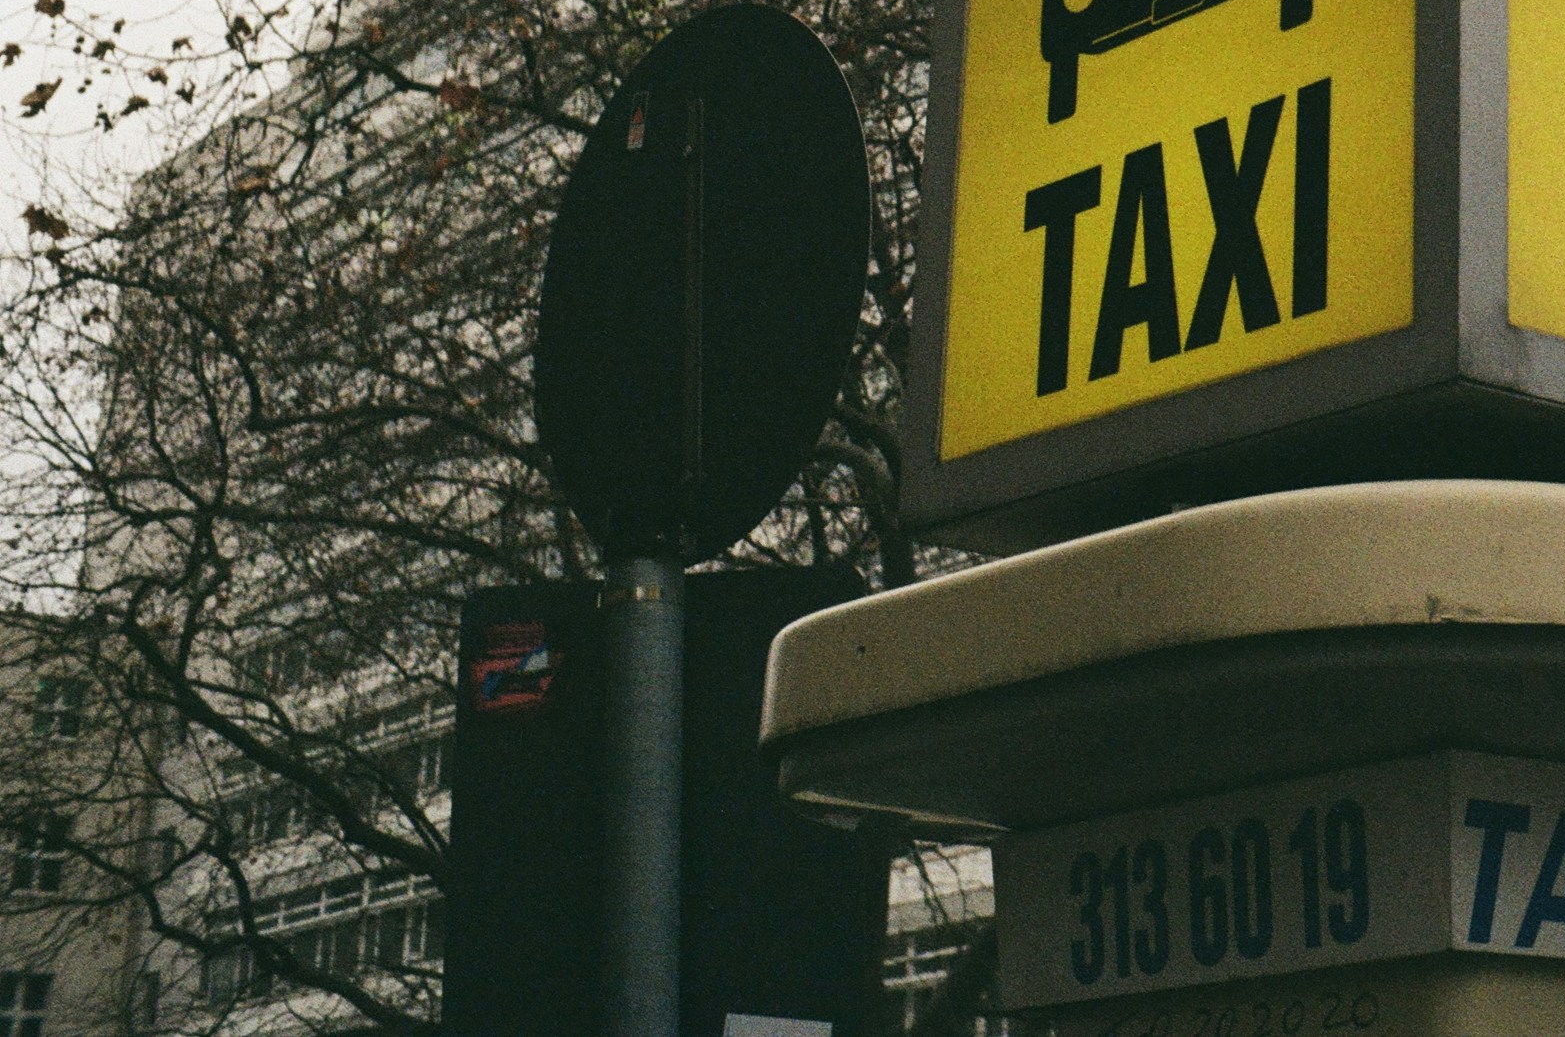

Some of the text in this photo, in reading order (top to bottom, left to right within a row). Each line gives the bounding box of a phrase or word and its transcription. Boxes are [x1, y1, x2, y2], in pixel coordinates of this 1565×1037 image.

[1024, 77, 1332, 397] TAXI
[1070, 797, 1371, 985] 313 60 19
